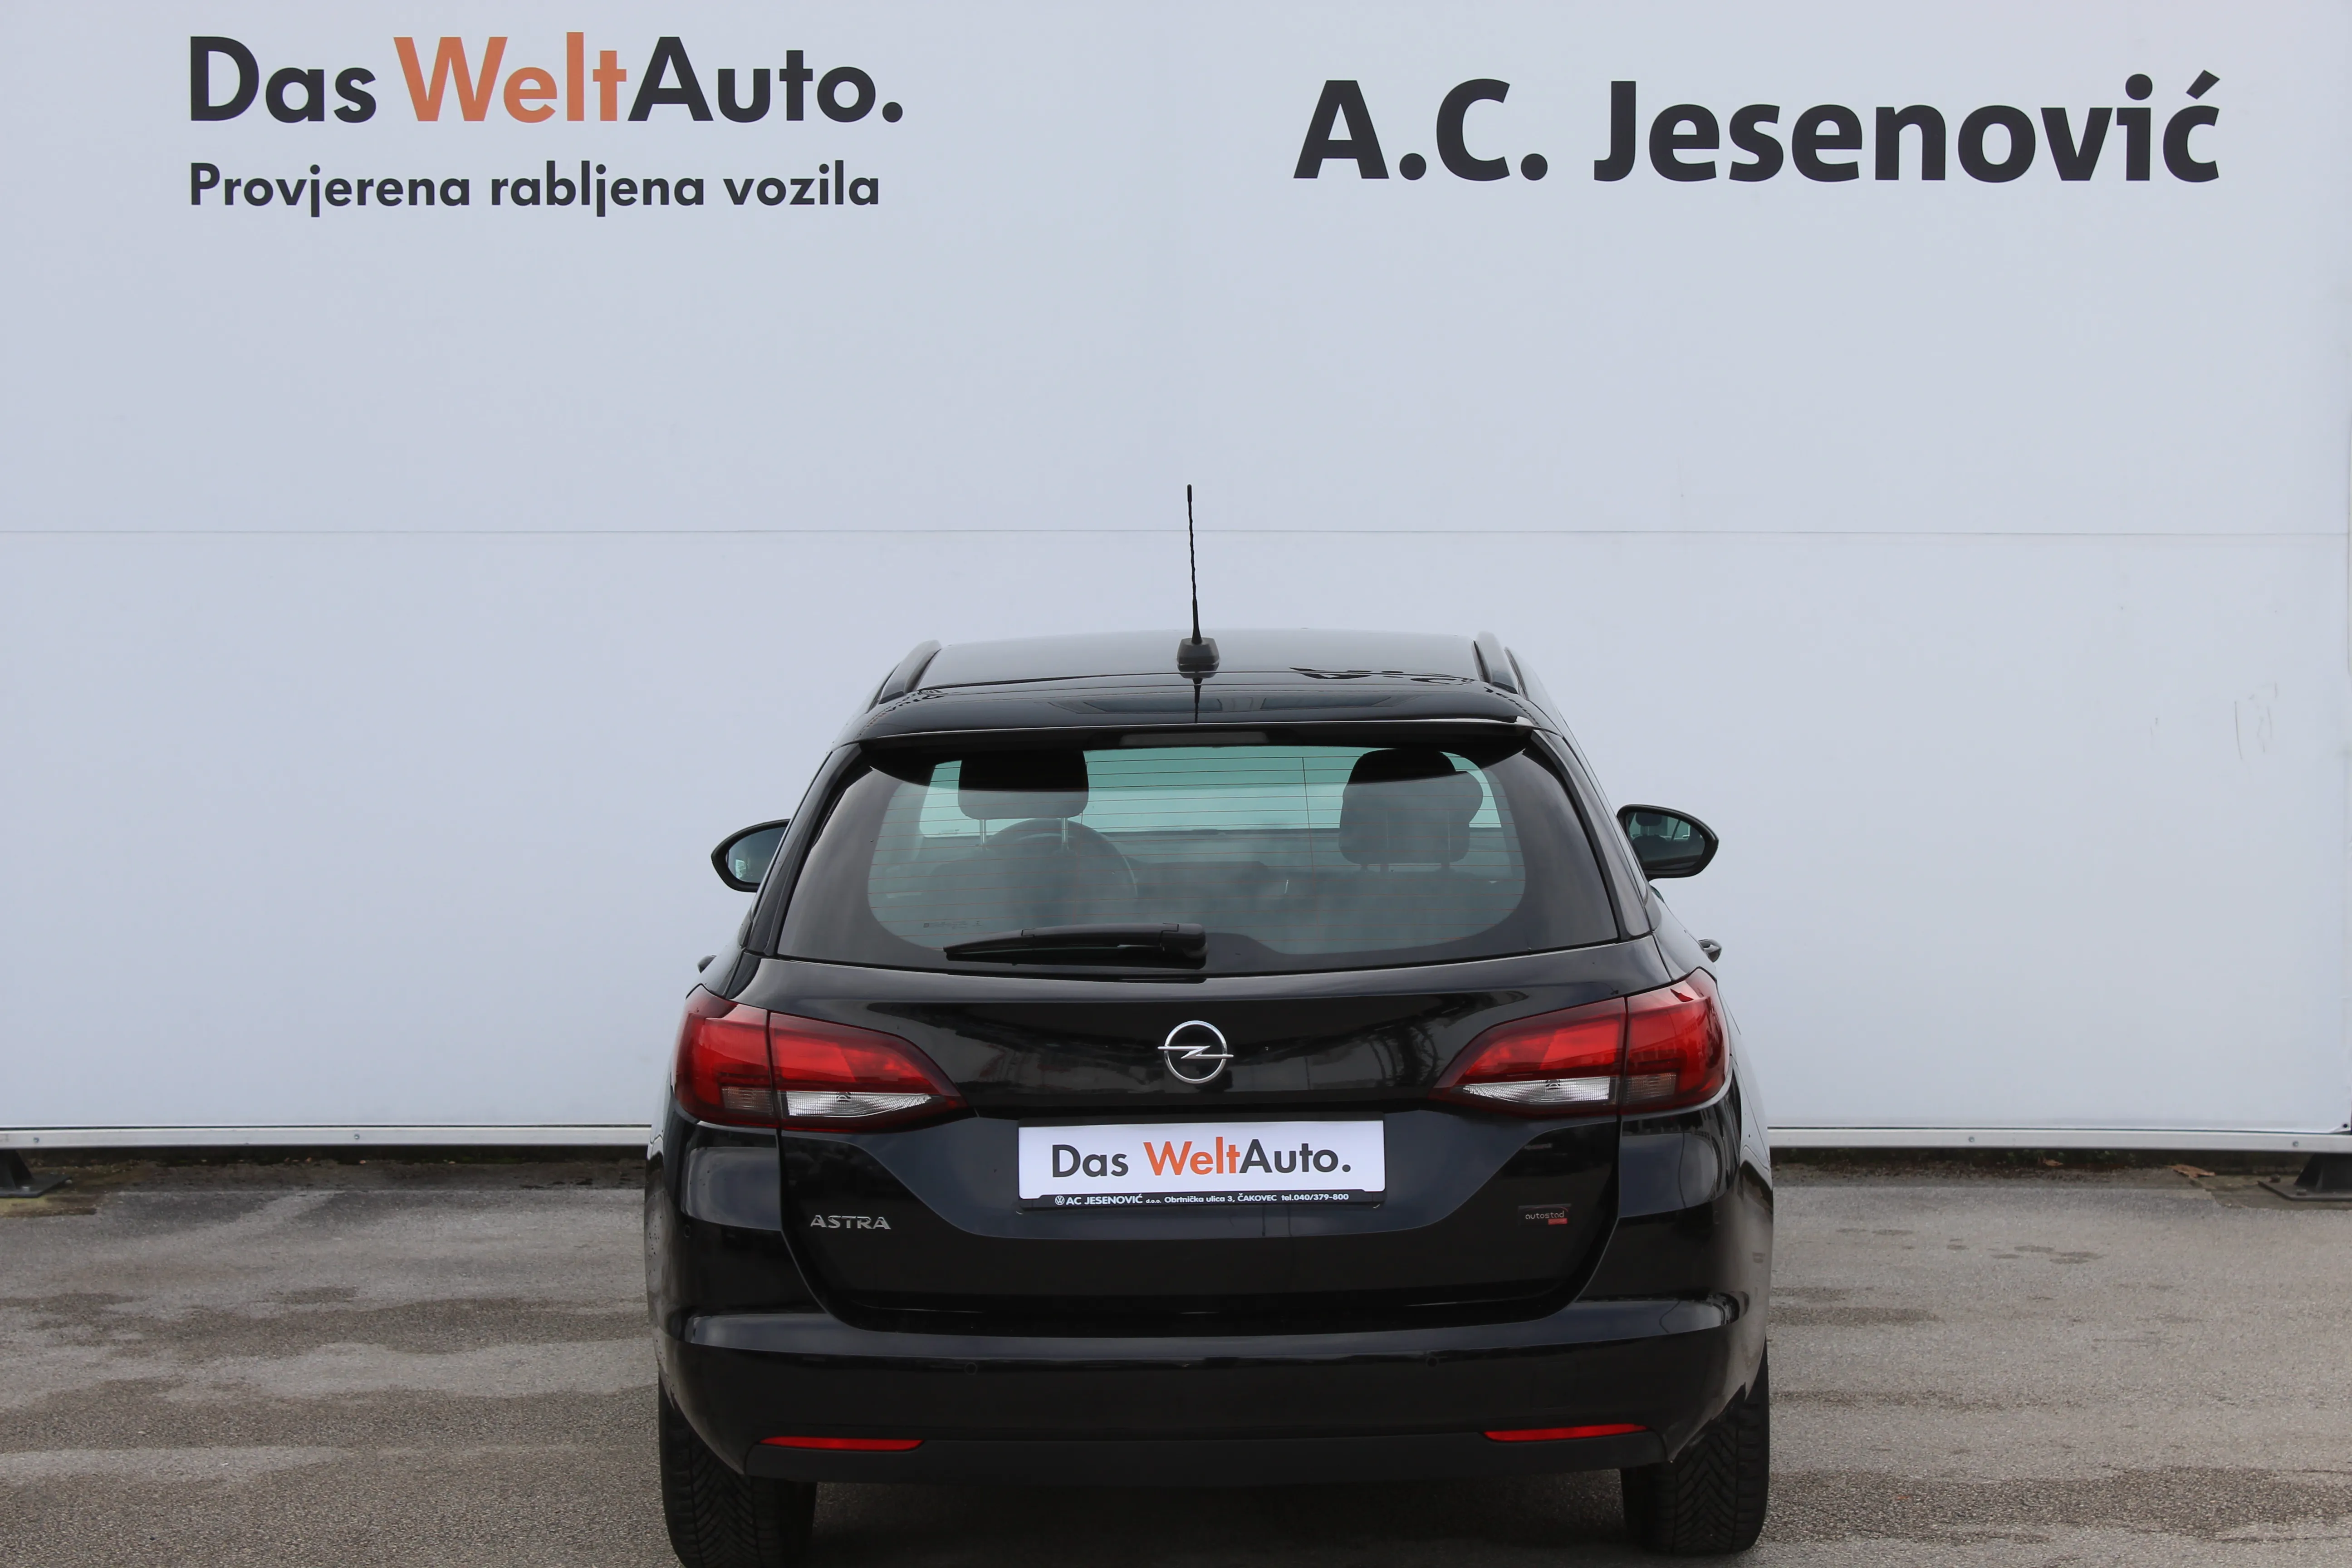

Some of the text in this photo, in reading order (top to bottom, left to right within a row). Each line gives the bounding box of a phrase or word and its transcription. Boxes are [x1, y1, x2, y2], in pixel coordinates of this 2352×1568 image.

[191, 32, 903, 123] Das WeltAuto.
[1294, 70, 2220, 183] A.C. Jesenović
[191, 160, 878, 217] Provjerena rabljena vozila
[1053, 1136, 1351, 1177] Das WeltAuto.
[1066, 1196, 1082, 1205] AC
[1084, 1193, 1143, 1205] JESENOVIĆ
[1237, 1192, 1277, 1202] ČAKOVEC
[1281, 1193, 1349, 1201] tel.040/379-800
[1525, 1210, 1564, 1220] autostad
[810, 1215, 891, 1230] ASTRA
